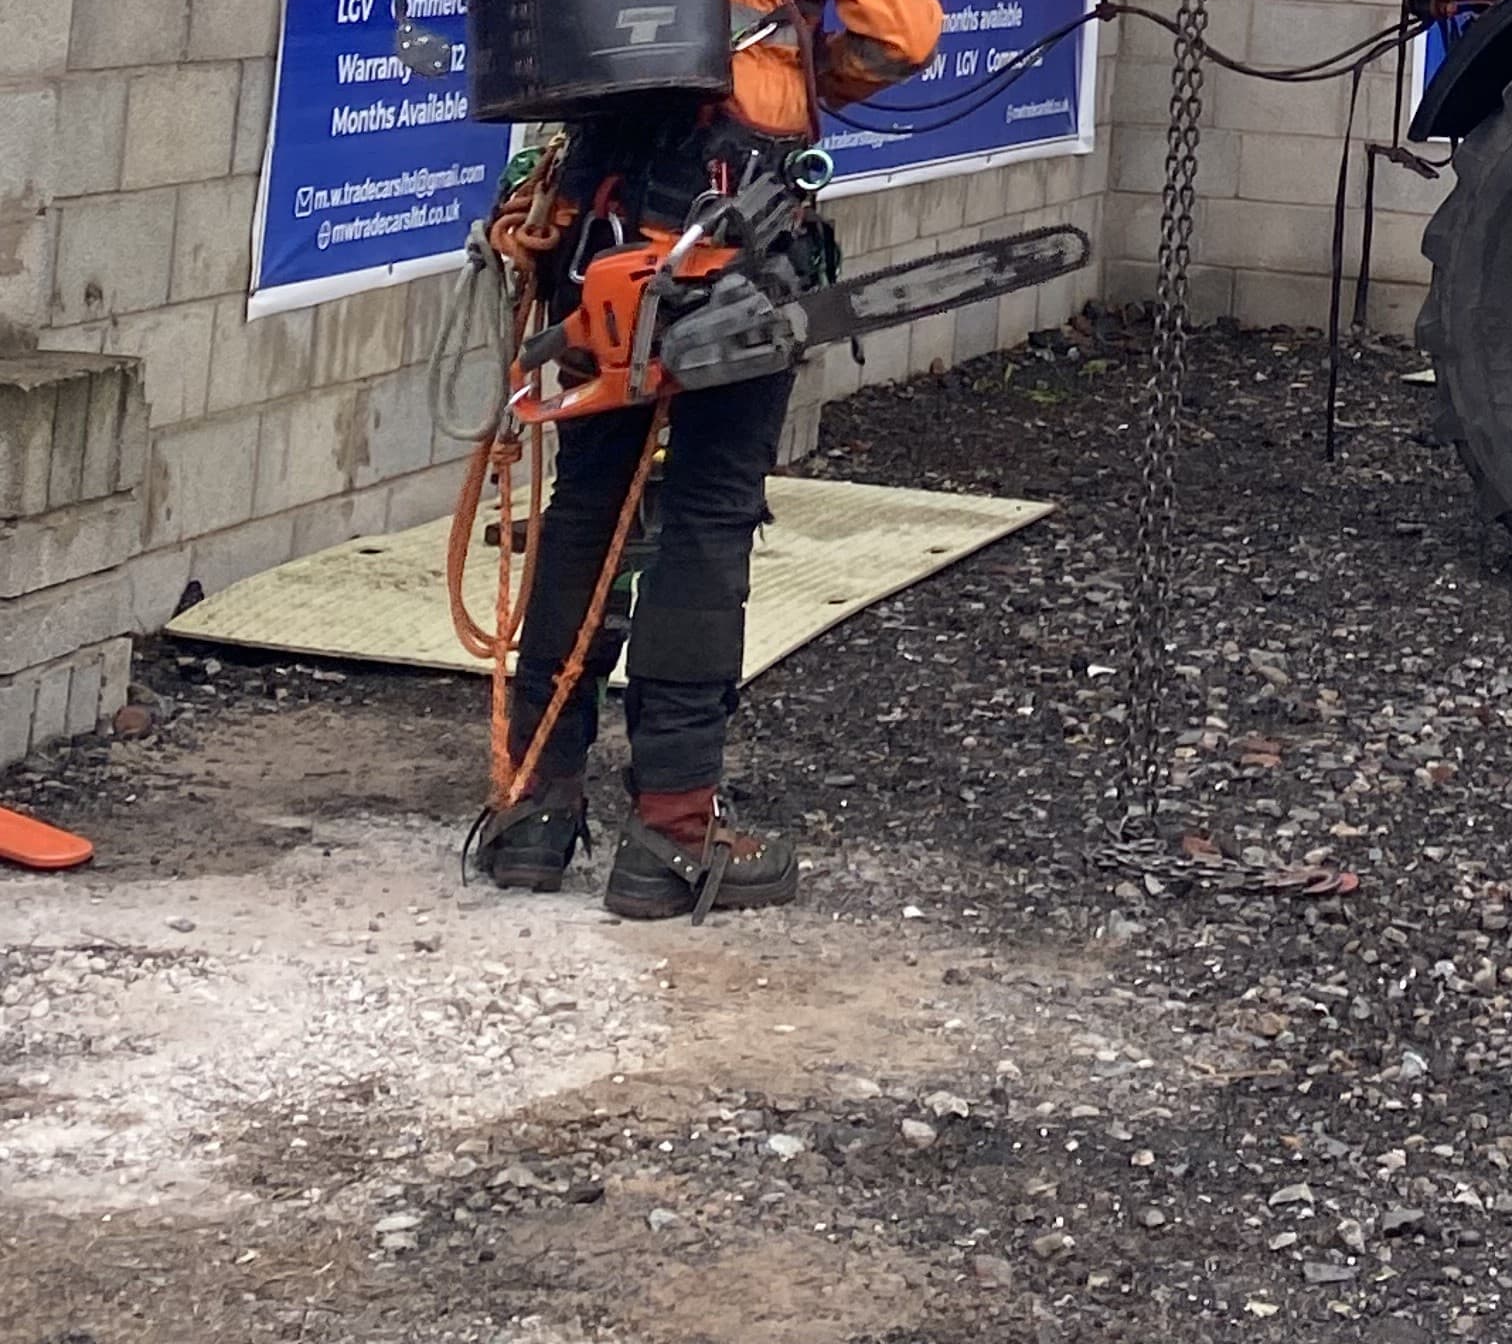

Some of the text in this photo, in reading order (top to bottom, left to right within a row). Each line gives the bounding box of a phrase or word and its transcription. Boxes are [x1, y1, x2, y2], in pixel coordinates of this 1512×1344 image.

[980, 1, 1022, 30] available
[956, 48, 978, 77] LGV
[331, 91, 468, 137] Months Available
